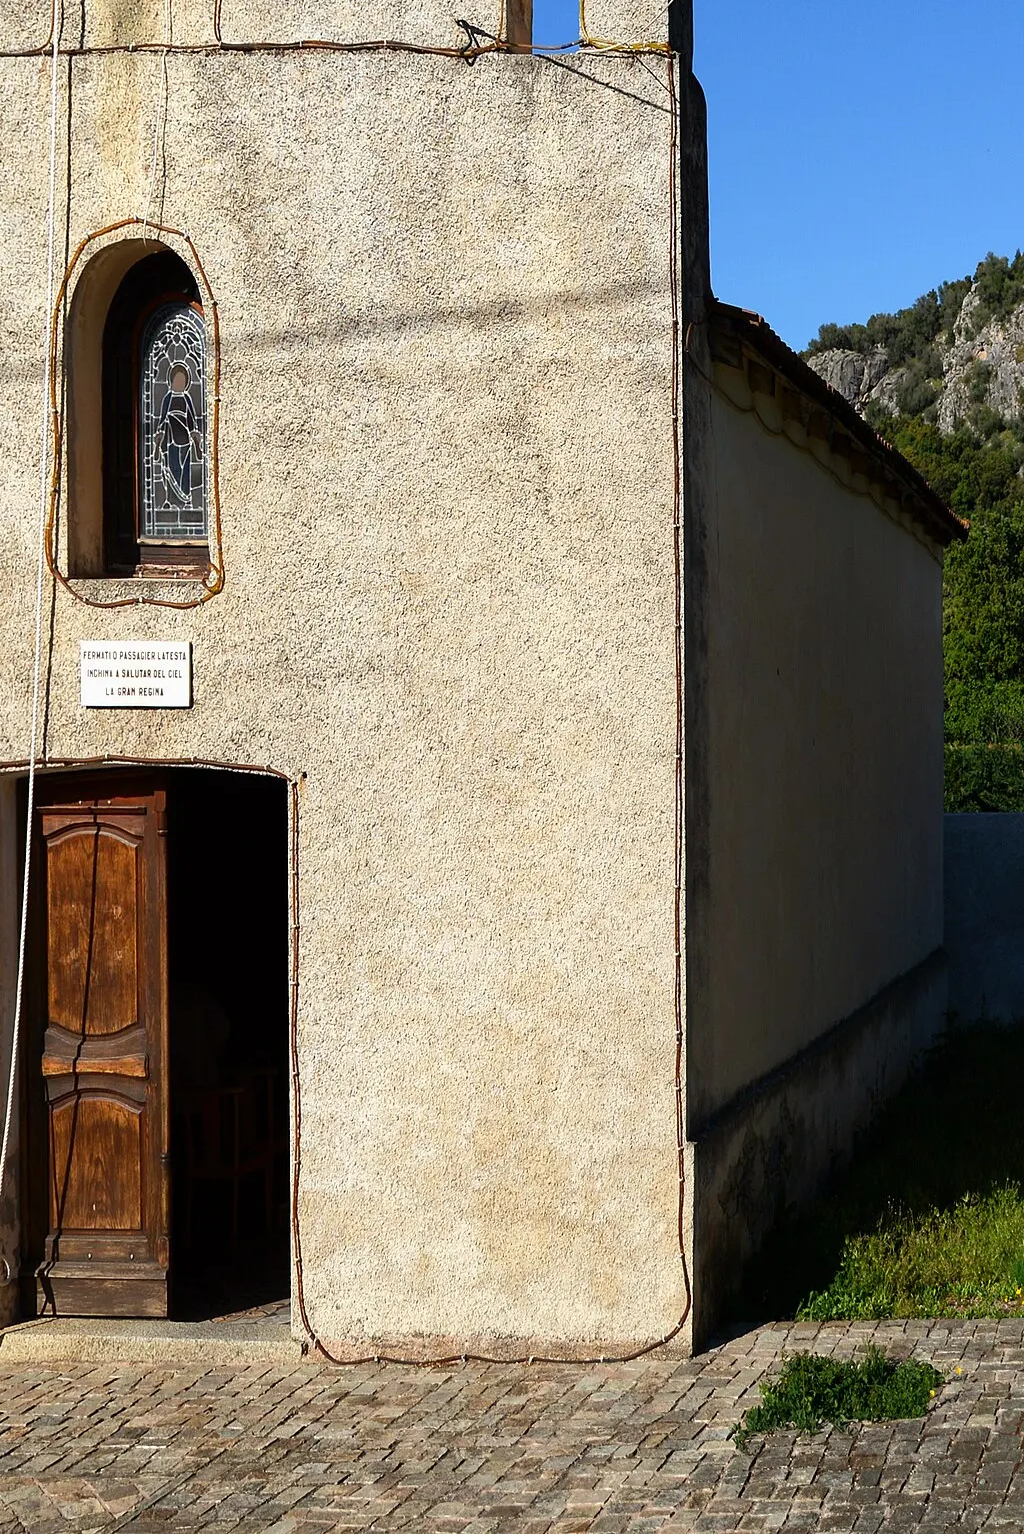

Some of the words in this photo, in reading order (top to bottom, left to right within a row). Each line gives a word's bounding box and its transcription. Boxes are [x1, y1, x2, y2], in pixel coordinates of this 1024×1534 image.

[83, 651, 111, 660] FERMATI
[112, 651, 118, 660] O
[120, 651, 156, 660] PASSAGIER
[87, 670, 112, 678] INCHINA
[116, 670, 119, 678] A
[122, 670, 152, 678] SALUTAR
[154, 670, 166, 678] DEL
[168, 670, 182, 678] CIEL
[106, 688, 114, 696] LA
[118, 688, 136, 696] GRAN
[138, 688, 164, 696] REGINA
